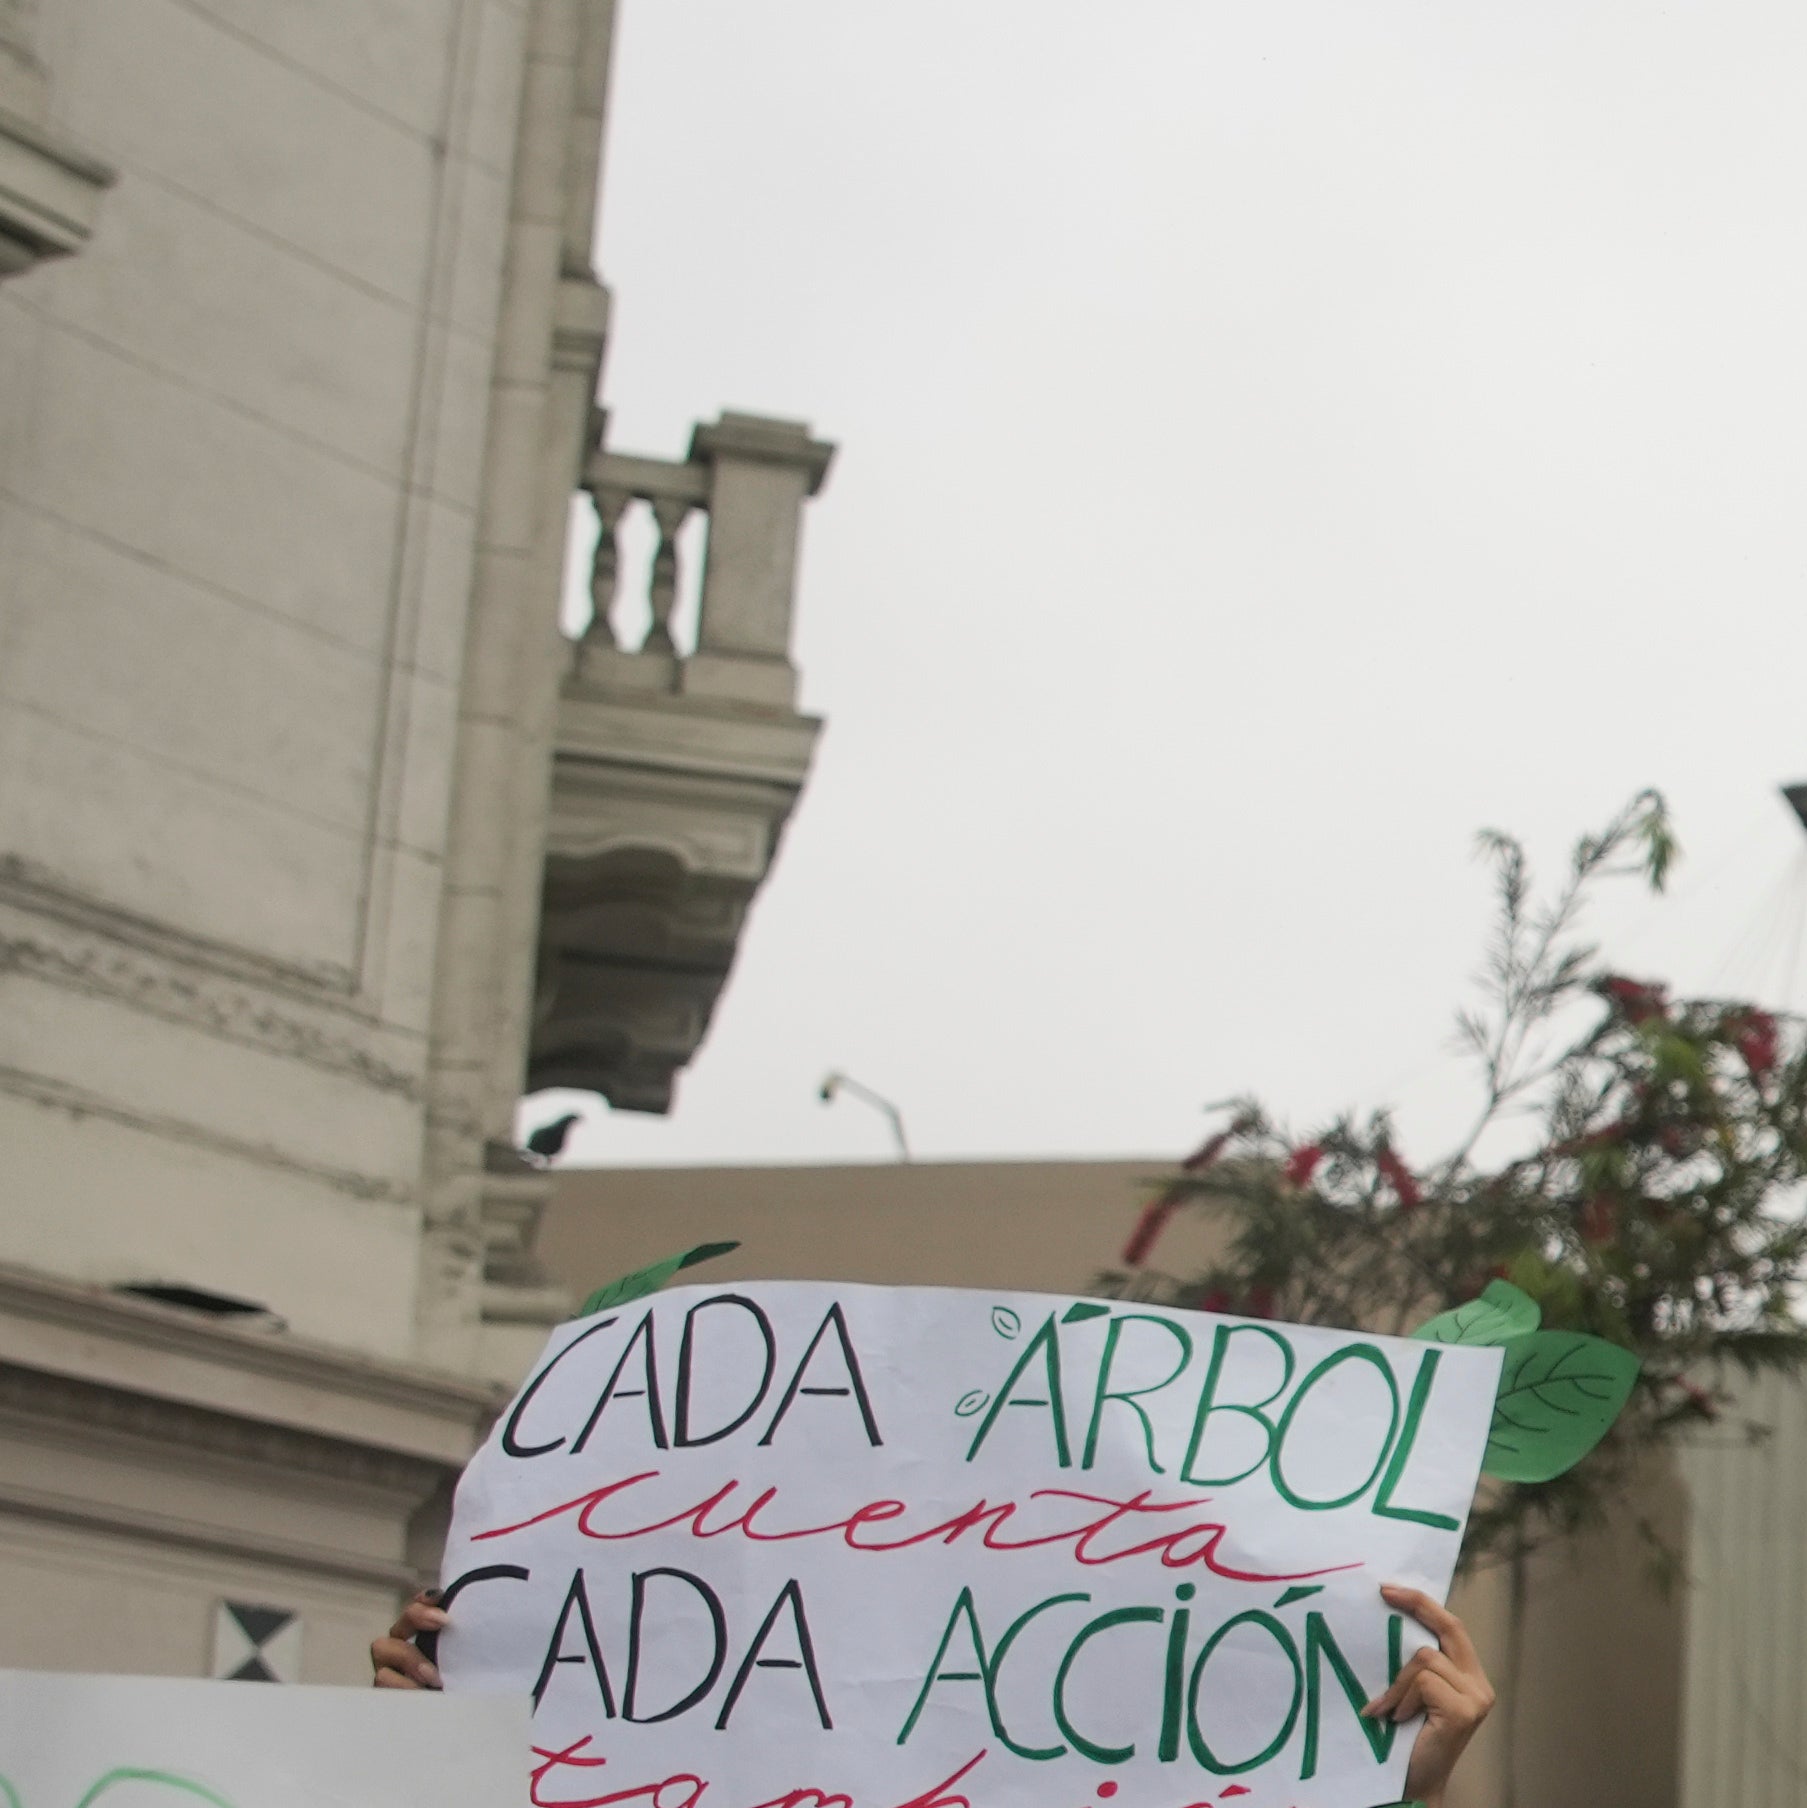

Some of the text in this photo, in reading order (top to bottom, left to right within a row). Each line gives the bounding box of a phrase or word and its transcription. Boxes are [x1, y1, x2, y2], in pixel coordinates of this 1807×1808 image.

[502, 1293, 1460, 1531] CADA ÁRBOL
[470, 1471, 1365, 1582] cuenta
